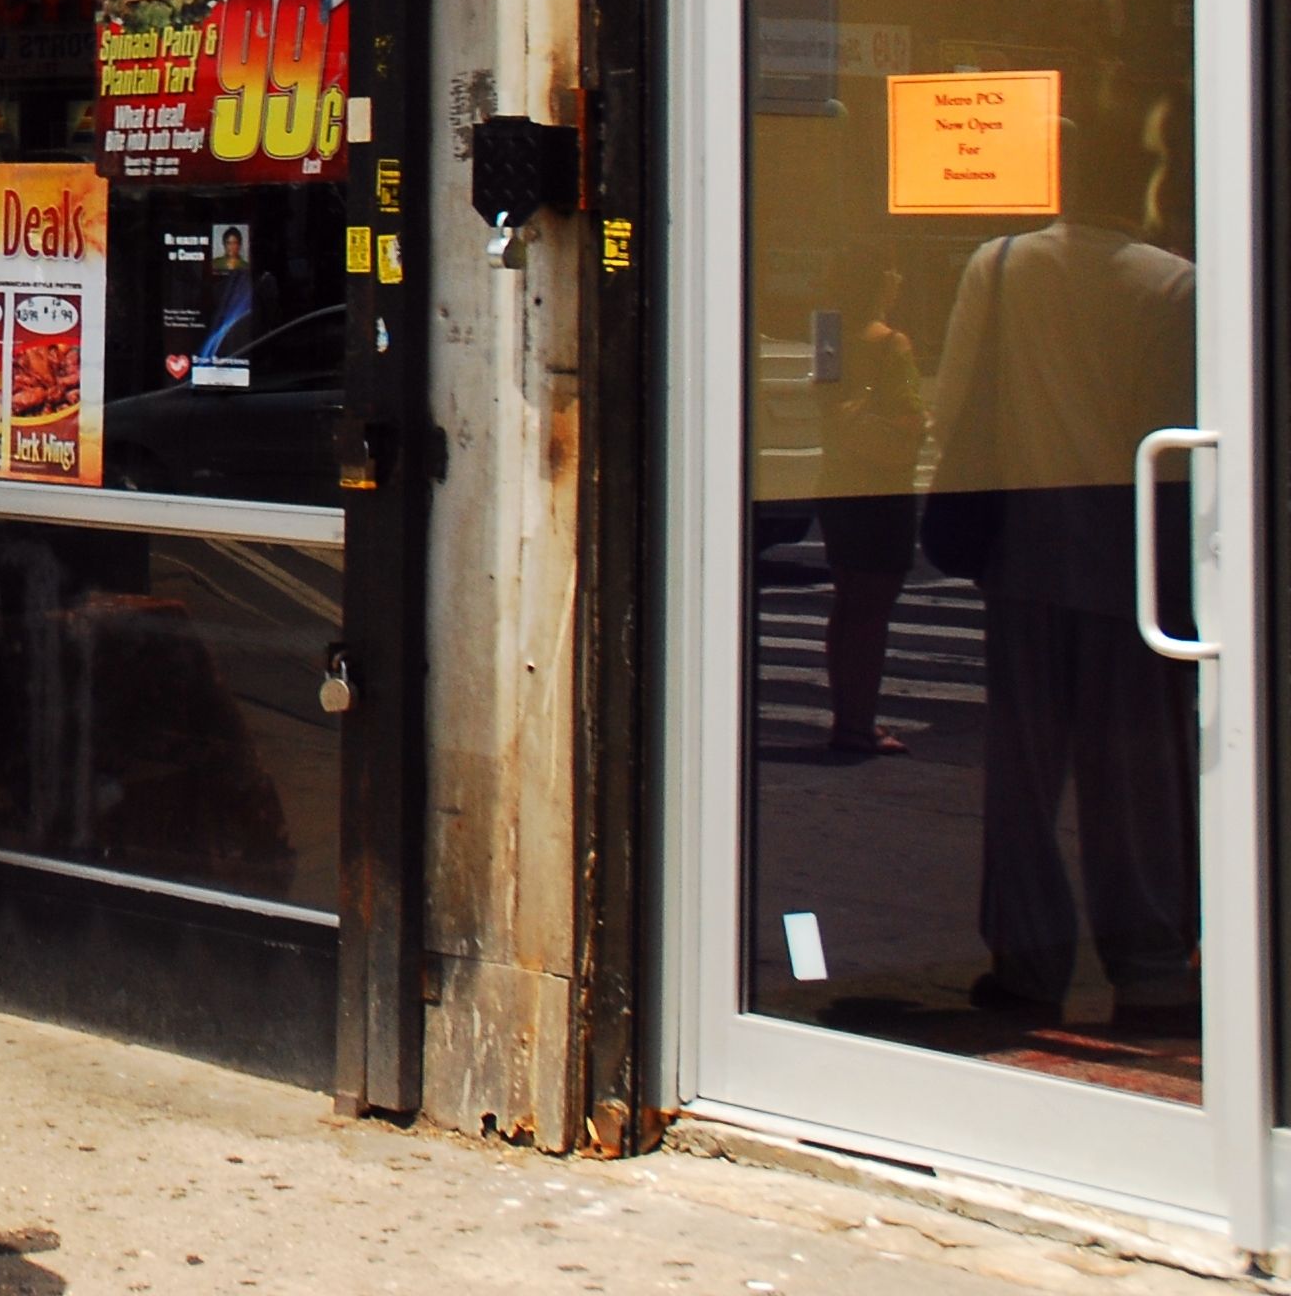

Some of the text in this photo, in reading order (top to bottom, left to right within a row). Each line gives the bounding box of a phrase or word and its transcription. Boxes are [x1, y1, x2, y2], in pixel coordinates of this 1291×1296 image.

[100, 24, 217, 65] Spinach Patty &
[101, 60, 196, 96] Plantain Tart
[934, 93, 1005, 106] Metro PCS
[114, 105, 145, 129] What
[968, 118, 1003, 134] Open
[958, 143, 981, 155] For
[943, 168, 997, 180] Business
[3, 187, 86, 261] Deals
[15, 432, 75, 471] Jerk Wings
